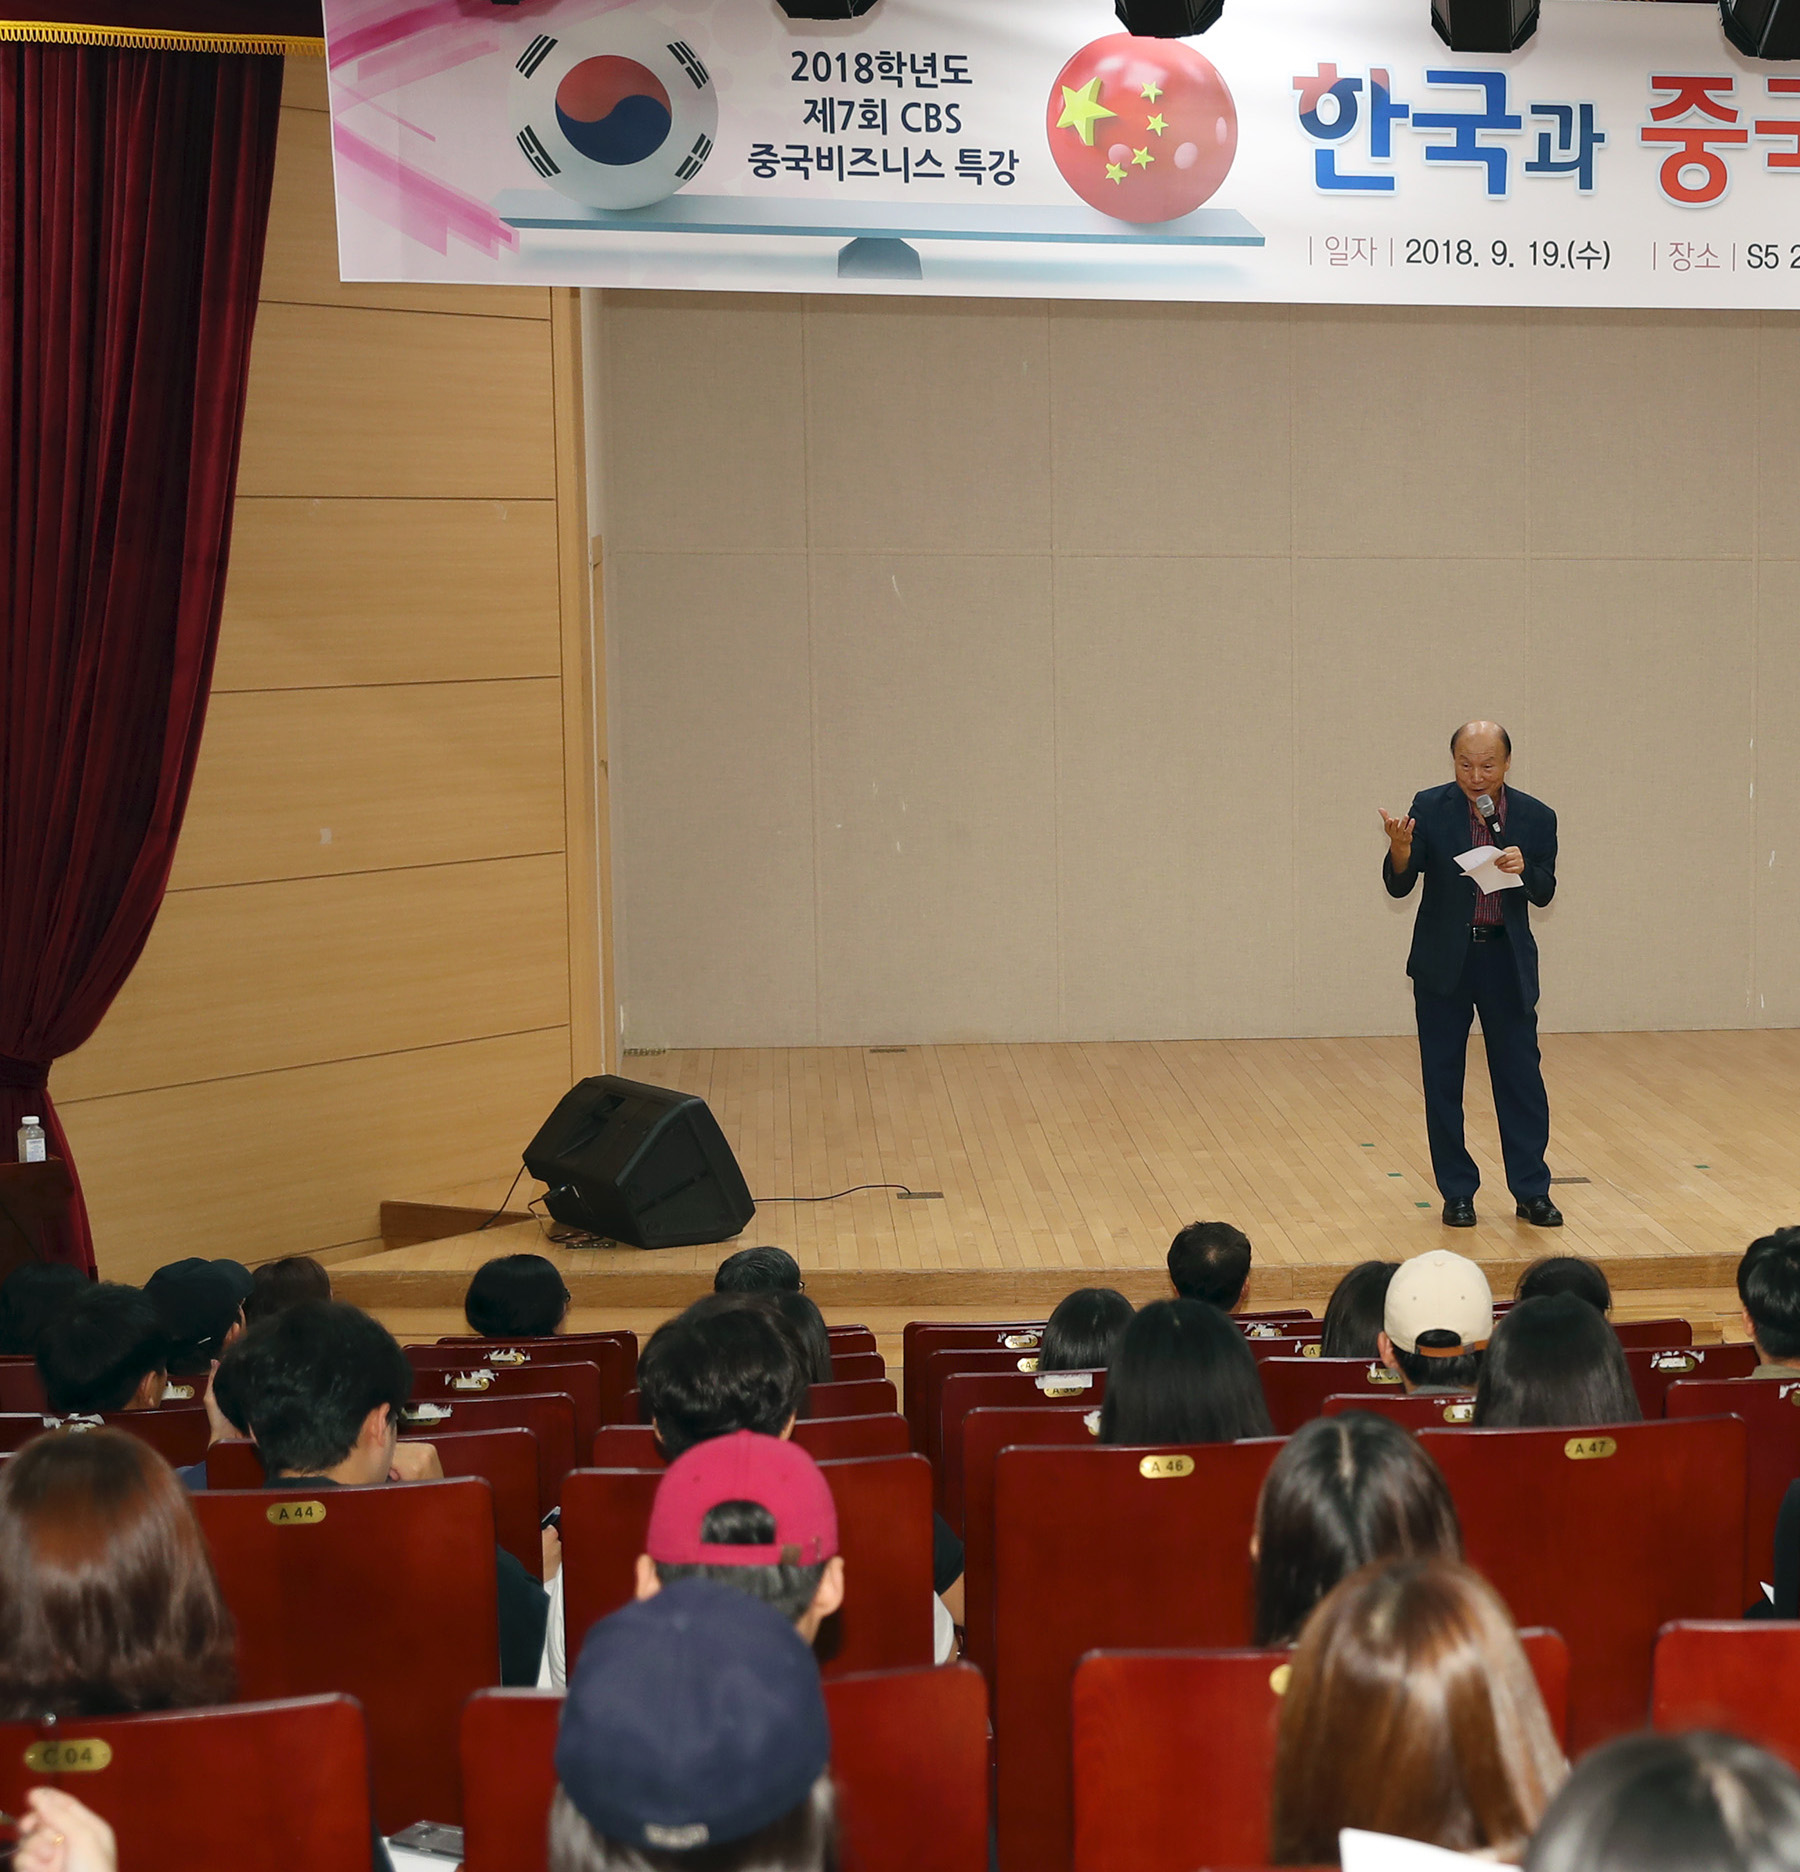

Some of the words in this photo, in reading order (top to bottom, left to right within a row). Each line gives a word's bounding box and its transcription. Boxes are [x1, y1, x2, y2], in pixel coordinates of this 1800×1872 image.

[792, 51, 972, 88] 2018학년도
[803, 97, 887, 135] 제7회
[900, 101, 962, 135] CBS
[1292, 62, 1606, 195] 한국과
[748, 144, 945, 183] 중국비즈니스
[955, 149, 1019, 186] 특강
[1325, 237, 1377, 266] 일자
[1406, 239, 1478, 267] 2018.
[1492, 240, 1513, 267] 9.
[1530, 241, 1610, 269] 19.(수)
[1669, 242, 1720, 271] 장소
[1747, 244, 1779, 269] S5
[1576, 1443, 1584, 1454] A
[1589, 1441, 1607, 1453] 47
[1151, 1461, 1160, 1472] A
[1166, 1460, 1184, 1472] 46
[279, 1508, 289, 1520] A
[295, 1506, 313, 1518] 44
[43, 1747, 57, 1766] C
[65, 1746, 93, 1764] 04
